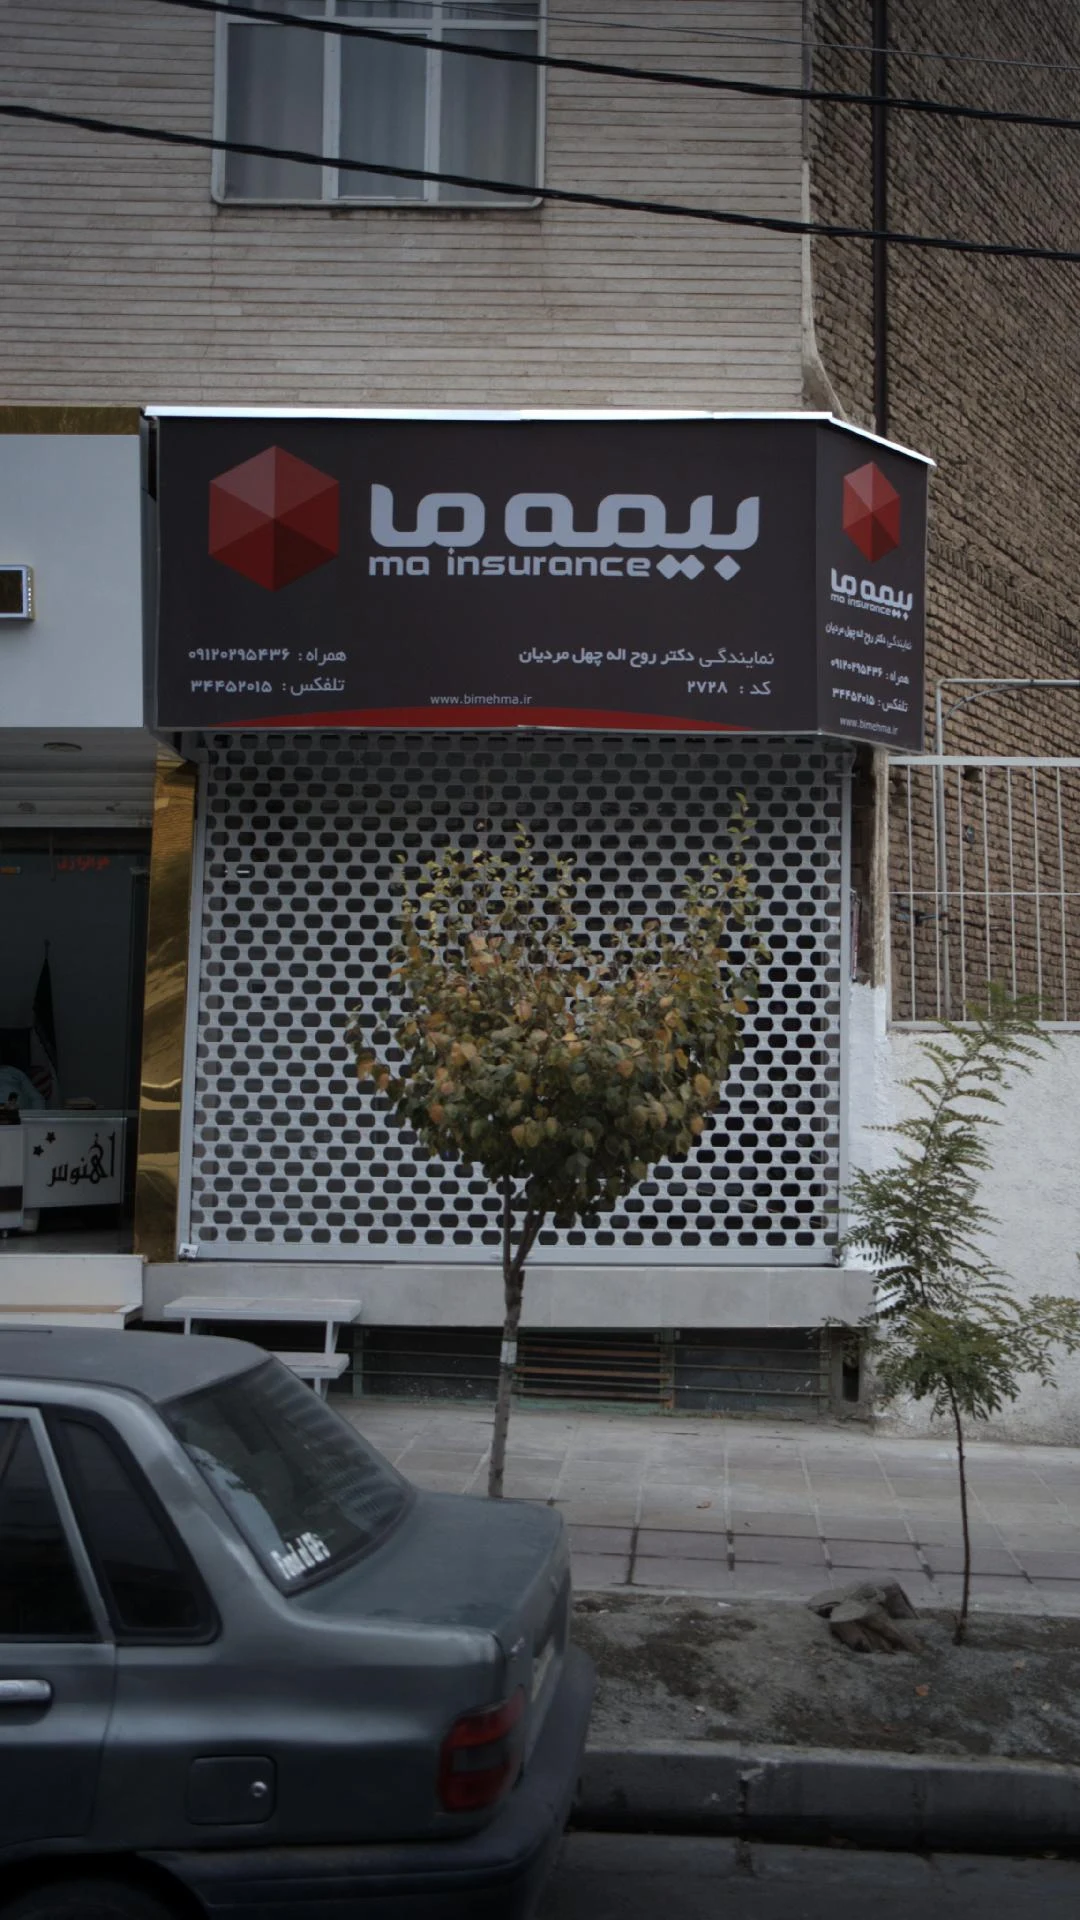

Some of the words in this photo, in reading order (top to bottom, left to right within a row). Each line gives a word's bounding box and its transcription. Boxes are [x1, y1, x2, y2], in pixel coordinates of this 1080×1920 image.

[369, 483, 486, 548] ما
[504, 492, 760, 581] بیمه
[368, 555, 430, 577] ma
[446, 546, 651, 578] insurance
[830, 567, 857, 597] ما
[830, 593, 845, 604] ma
[847, 597, 892, 617] insurance
[859, 579, 914, 622] بیمه
[518, 647, 570, 665] مردیان
[571, 647, 604, 668] چهل
[629, 649, 657, 668] روح
[660, 648, 696, 666] دکتر
[699, 647, 775, 669] نمایندگی
[686, 679, 729, 695] ۲۷۲۸
[429, 693, 533, 706] www.bimehma.ir
